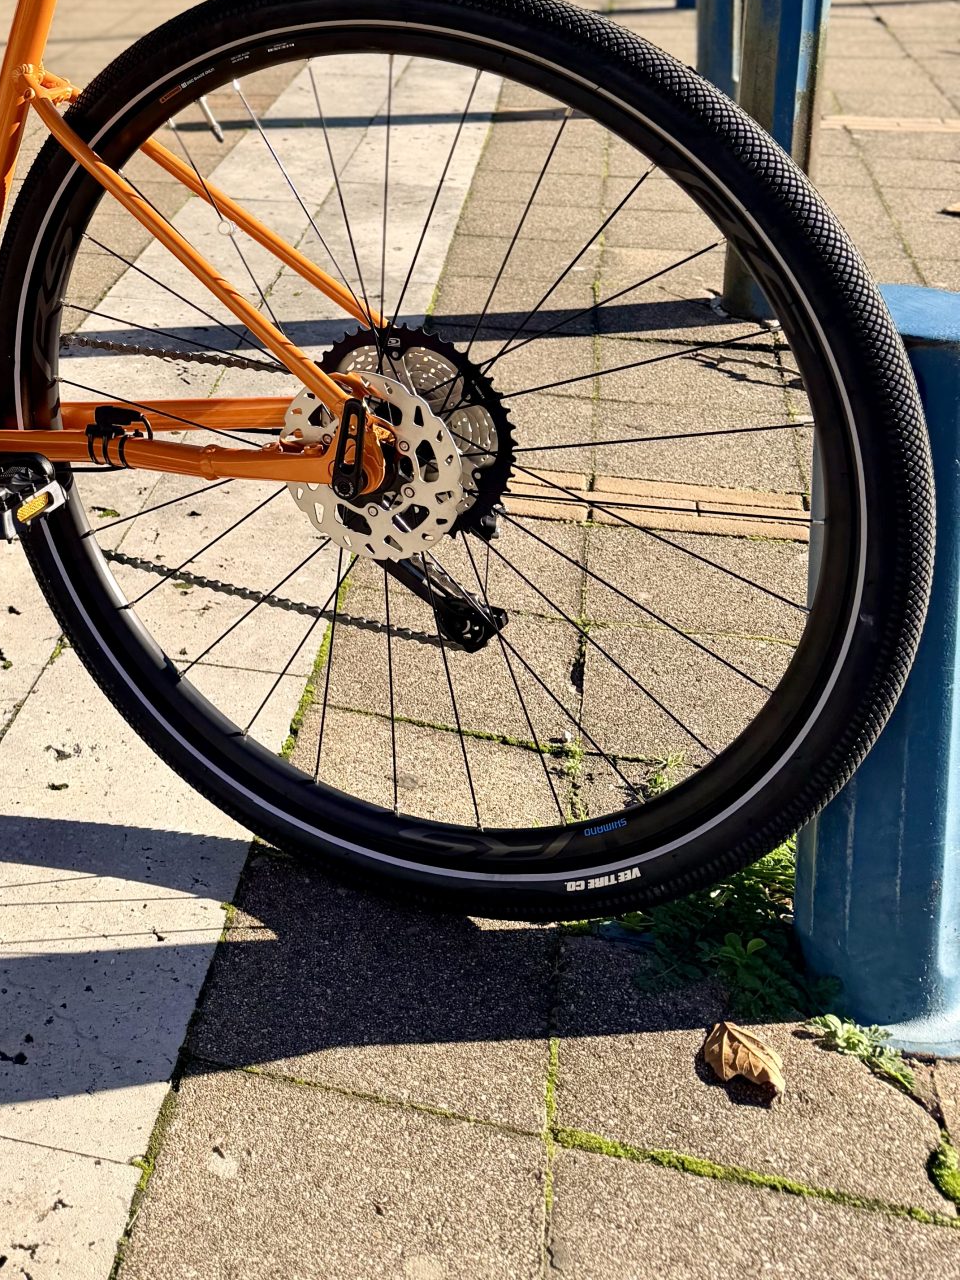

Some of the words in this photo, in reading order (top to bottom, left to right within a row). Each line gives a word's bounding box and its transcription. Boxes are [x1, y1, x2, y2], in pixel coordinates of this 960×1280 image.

[583, 817, 628, 837] SHIMANO
[587, 874, 618, 890] TIRE
[617, 867, 642, 883] VEE
